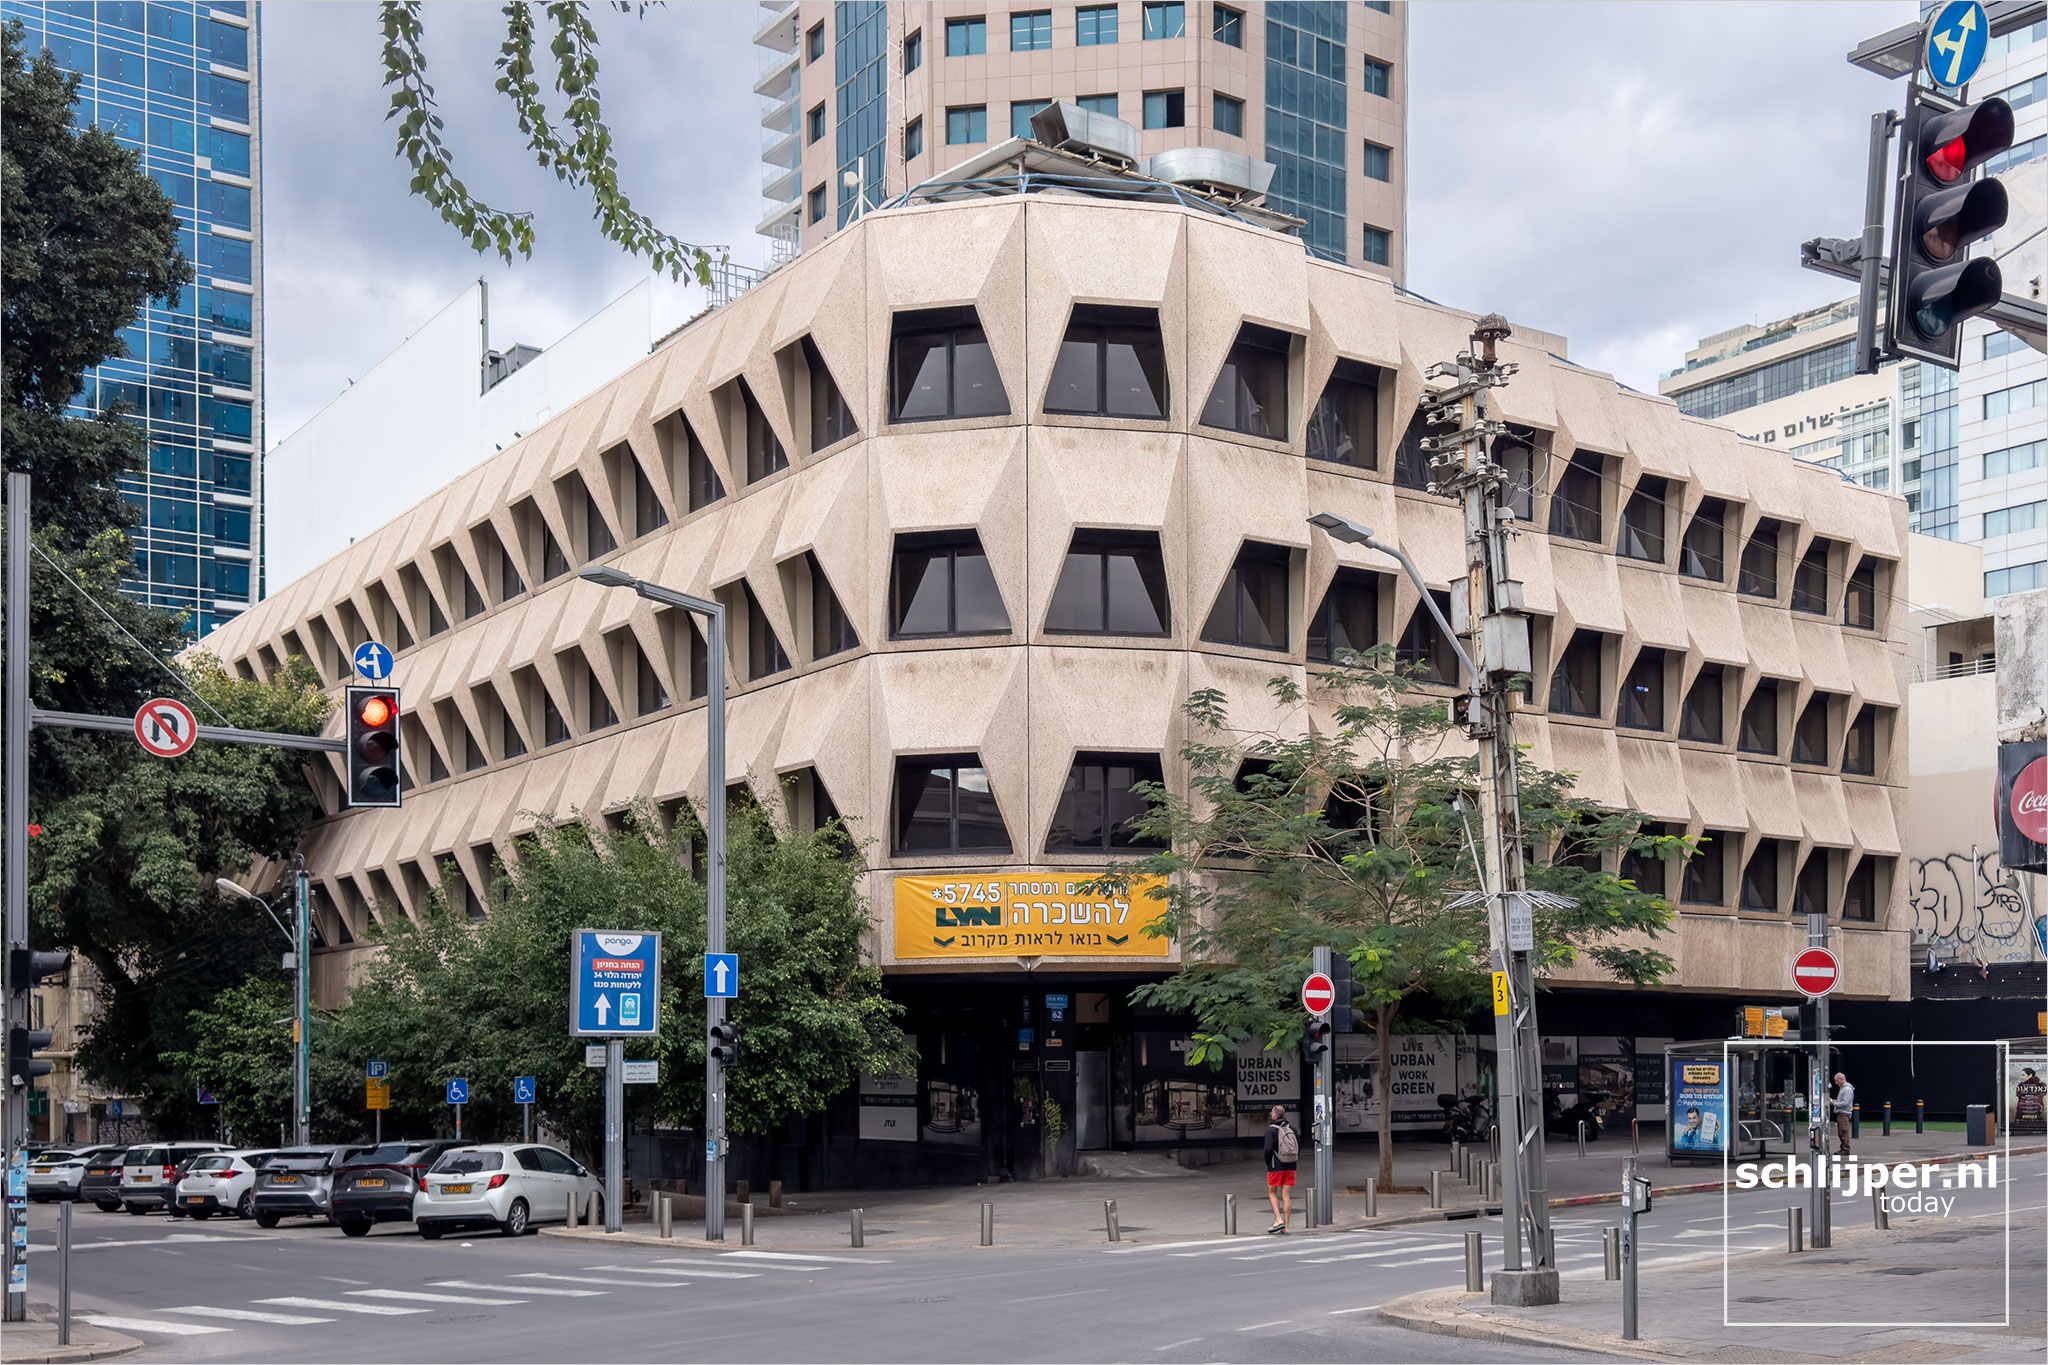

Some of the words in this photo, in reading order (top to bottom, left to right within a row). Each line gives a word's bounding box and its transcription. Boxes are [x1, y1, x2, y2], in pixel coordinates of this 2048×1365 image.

[1783, 412, 1834, 438] שלום
[1008, 882, 1060, 896] ומסחר
[935, 906, 1001, 927] LYN
[1012, 898, 1130, 925] להשכרה
[961, 933, 1008, 948] מקרוב
[1014, 931, 1064, 946] לראות
[1070, 932, 1102, 945] בואו
[1402, 1042, 1424, 1052] LIVE
[1239, 1057, 1282, 1069] URBAN
[1390, 1054, 1435, 1066] URBAN
[1398, 1070, 1428, 1080] WORK
[1244, 1084, 1278, 1096] YARD
[1391, 1082, 1435, 1095] GREEN
